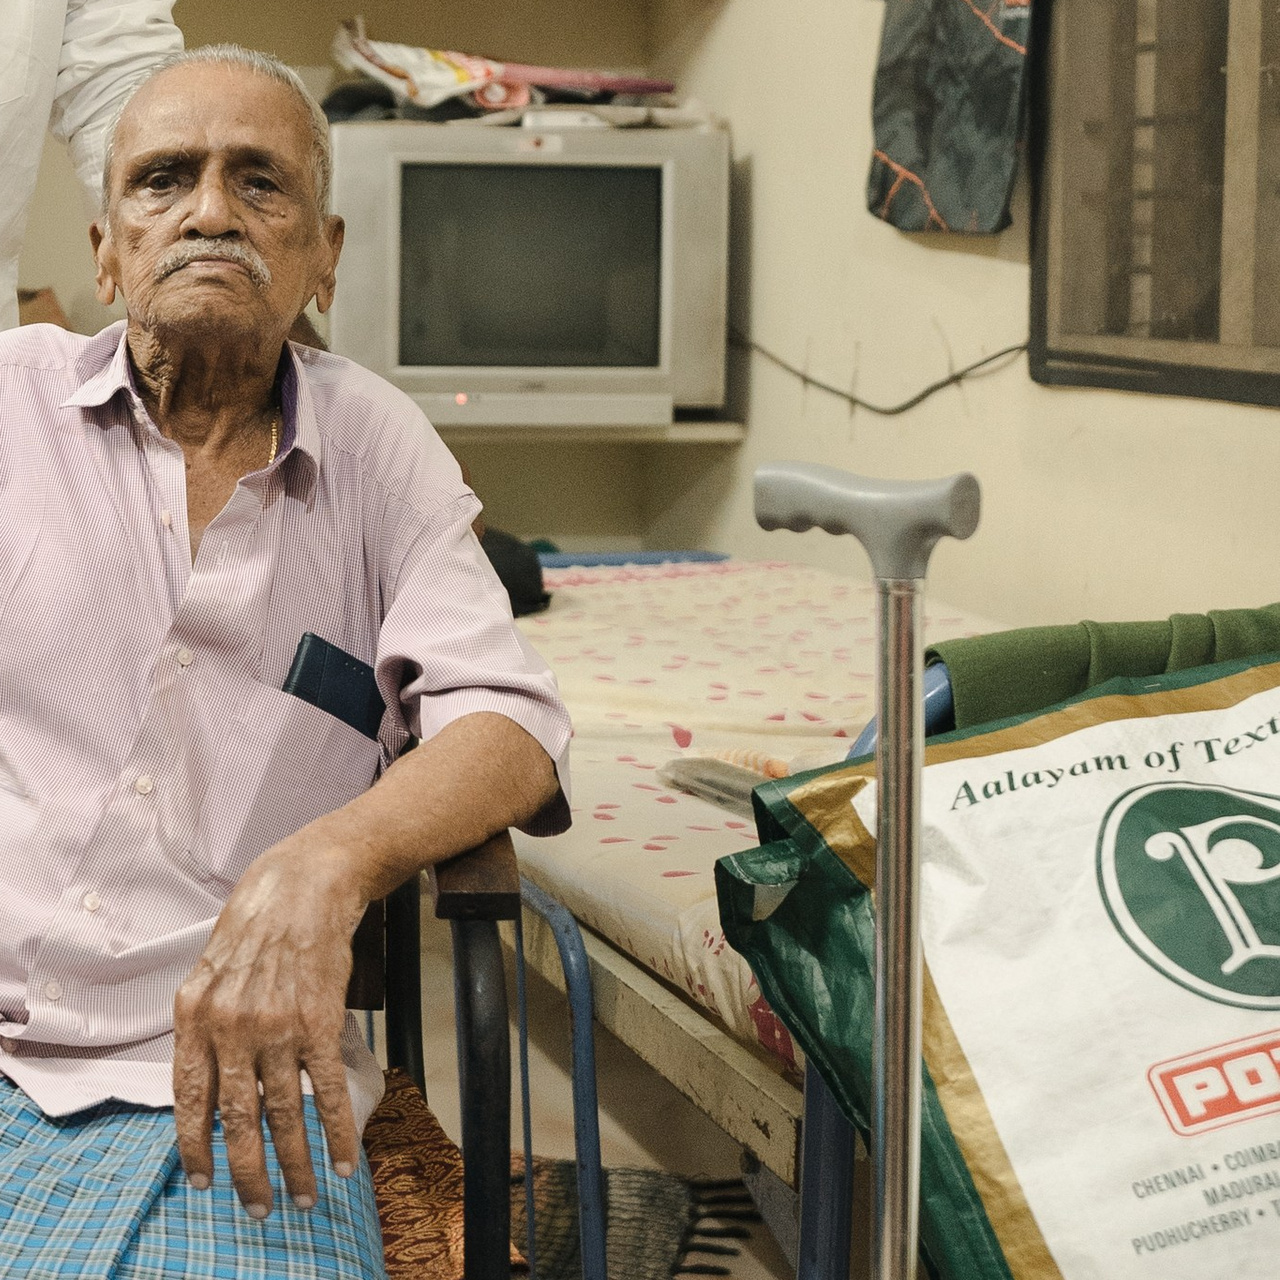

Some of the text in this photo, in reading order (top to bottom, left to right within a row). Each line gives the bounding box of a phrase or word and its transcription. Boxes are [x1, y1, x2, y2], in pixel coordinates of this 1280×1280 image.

[950, 753, 1130, 811] Aalayam
[1144, 741, 1184, 773] of
[1172, 1047, 1280, 1119] PO
[1132, 1163, 1206, 1199] CHENNAI
[1131, 1206, 1253, 1256] PUDHUCHERRY
